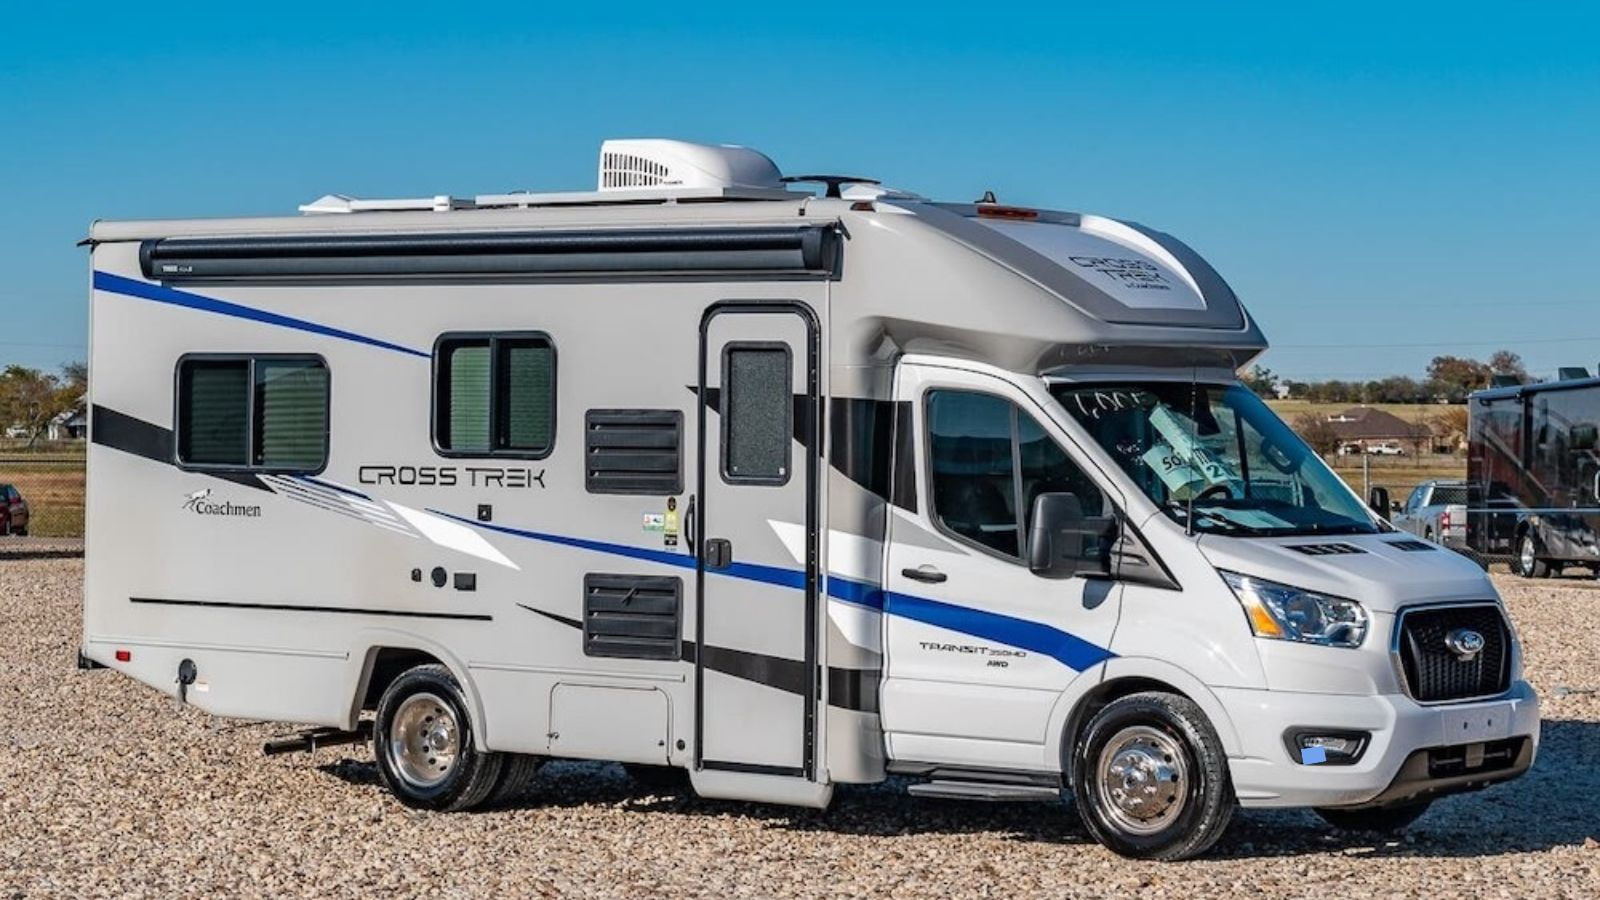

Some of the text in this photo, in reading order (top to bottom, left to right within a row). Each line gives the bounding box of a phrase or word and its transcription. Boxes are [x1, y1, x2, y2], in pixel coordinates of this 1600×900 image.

[1068, 256, 1158, 271] CROSS
[1096, 269, 1170, 284] TREK
[359, 466, 546, 489] CROSS TREK
[196, 501, 262, 517] Coachmen
[919, 641, 989, 655] TRANSIT
[986, 659, 1009, 668] AWD
